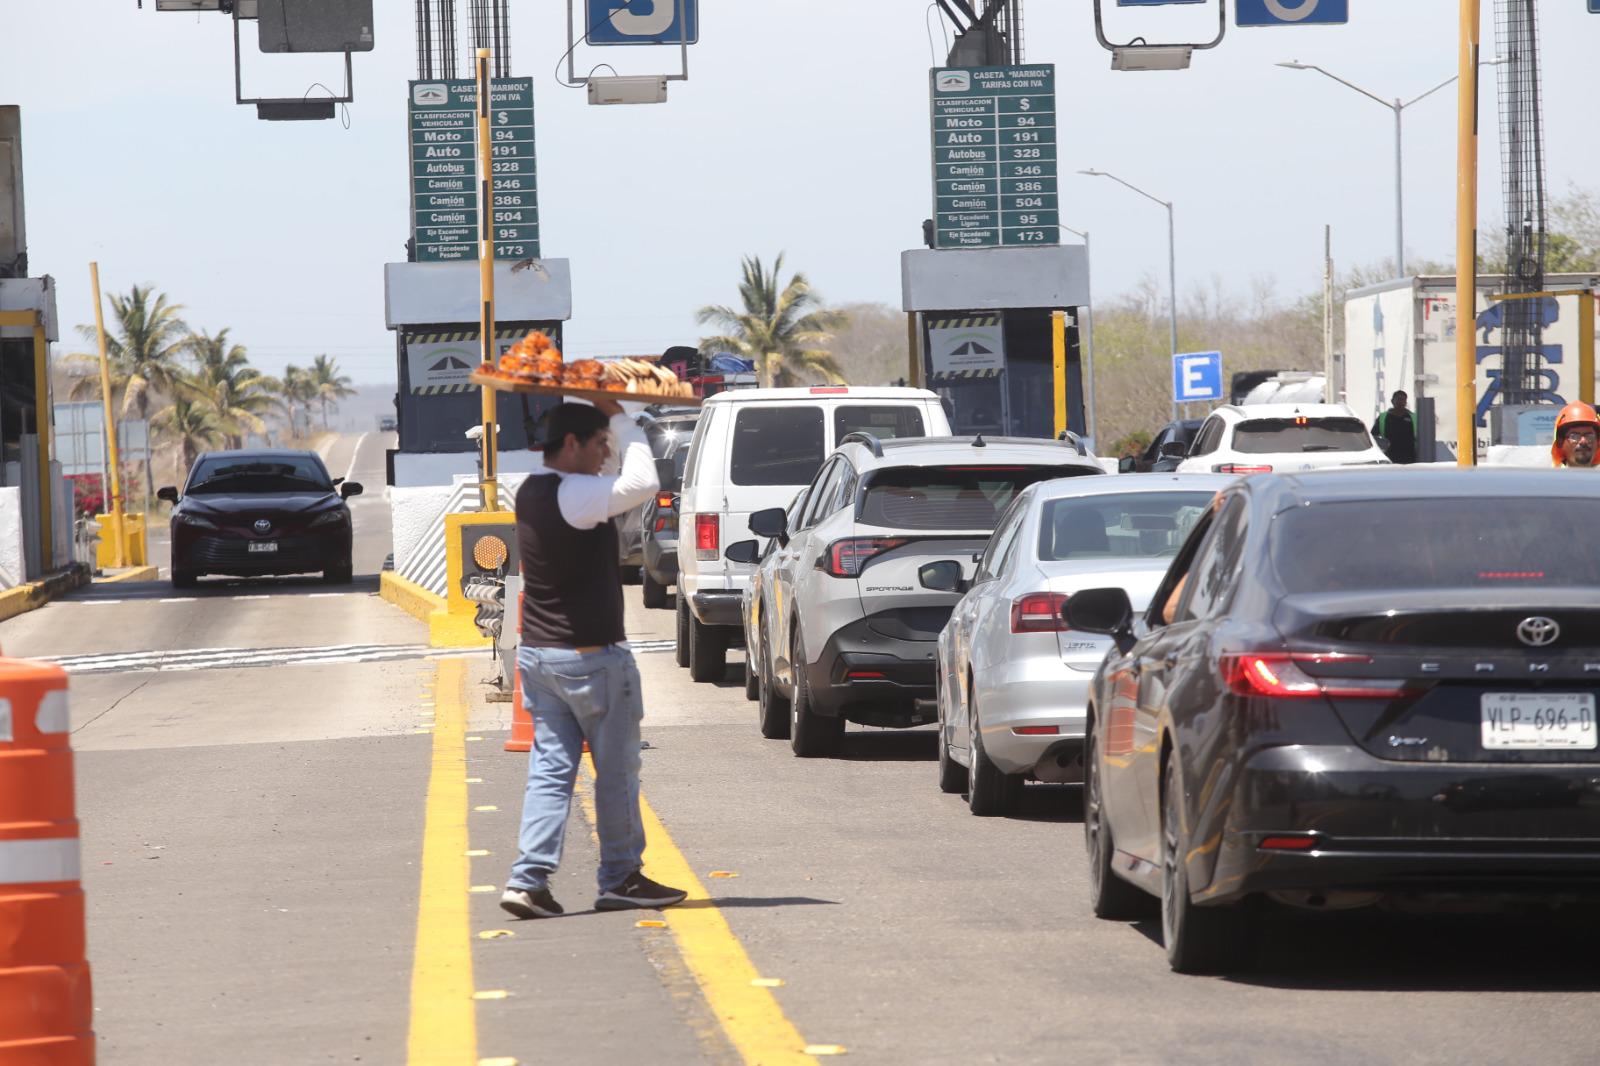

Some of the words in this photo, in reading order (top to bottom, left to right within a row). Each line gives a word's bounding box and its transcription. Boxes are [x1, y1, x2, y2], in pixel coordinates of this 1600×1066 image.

[1020, 98, 1030, 110] $
[498, 112, 508, 124] $
[946, 118, 982, 127] Moto
[1017, 117, 1036, 126] 94
[424, 132, 461, 141] Moto
[496, 131, 514, 140] 94
[948, 133, 982, 143] Auto
[1013, 132, 1038, 141] 191
[426, 147, 460, 157] Auto
[492, 146, 517, 155] 191
[949, 149, 985, 159] Autobus
[1014, 149, 1040, 158] 328
[427, 163, 464, 173] Autobus
[492, 163, 519, 171] 328
[950, 165, 984, 174] Camión
[1014, 166, 1041, 175] 346
[429, 179, 463, 188] Camión
[494, 180, 520, 189] 346
[951, 182, 985, 191] Camión
[1015, 182, 1042, 191] 386
[430, 196, 464, 205] Camión
[494, 196, 521, 205] 386
[952, 199, 986, 208] Camión
[1016, 198, 1042, 207] 504
[431, 213, 465, 222] Camión
[495, 212, 522, 221] 504
[1020, 215, 1038, 224] 95
[500, 229, 517, 238] 95
[1017, 231, 1044, 241] 173
[497, 246, 524, 255] 173
[1183, 357, 1212, 396] E
[1487, 707, 1591, 731] VLP-696-D
